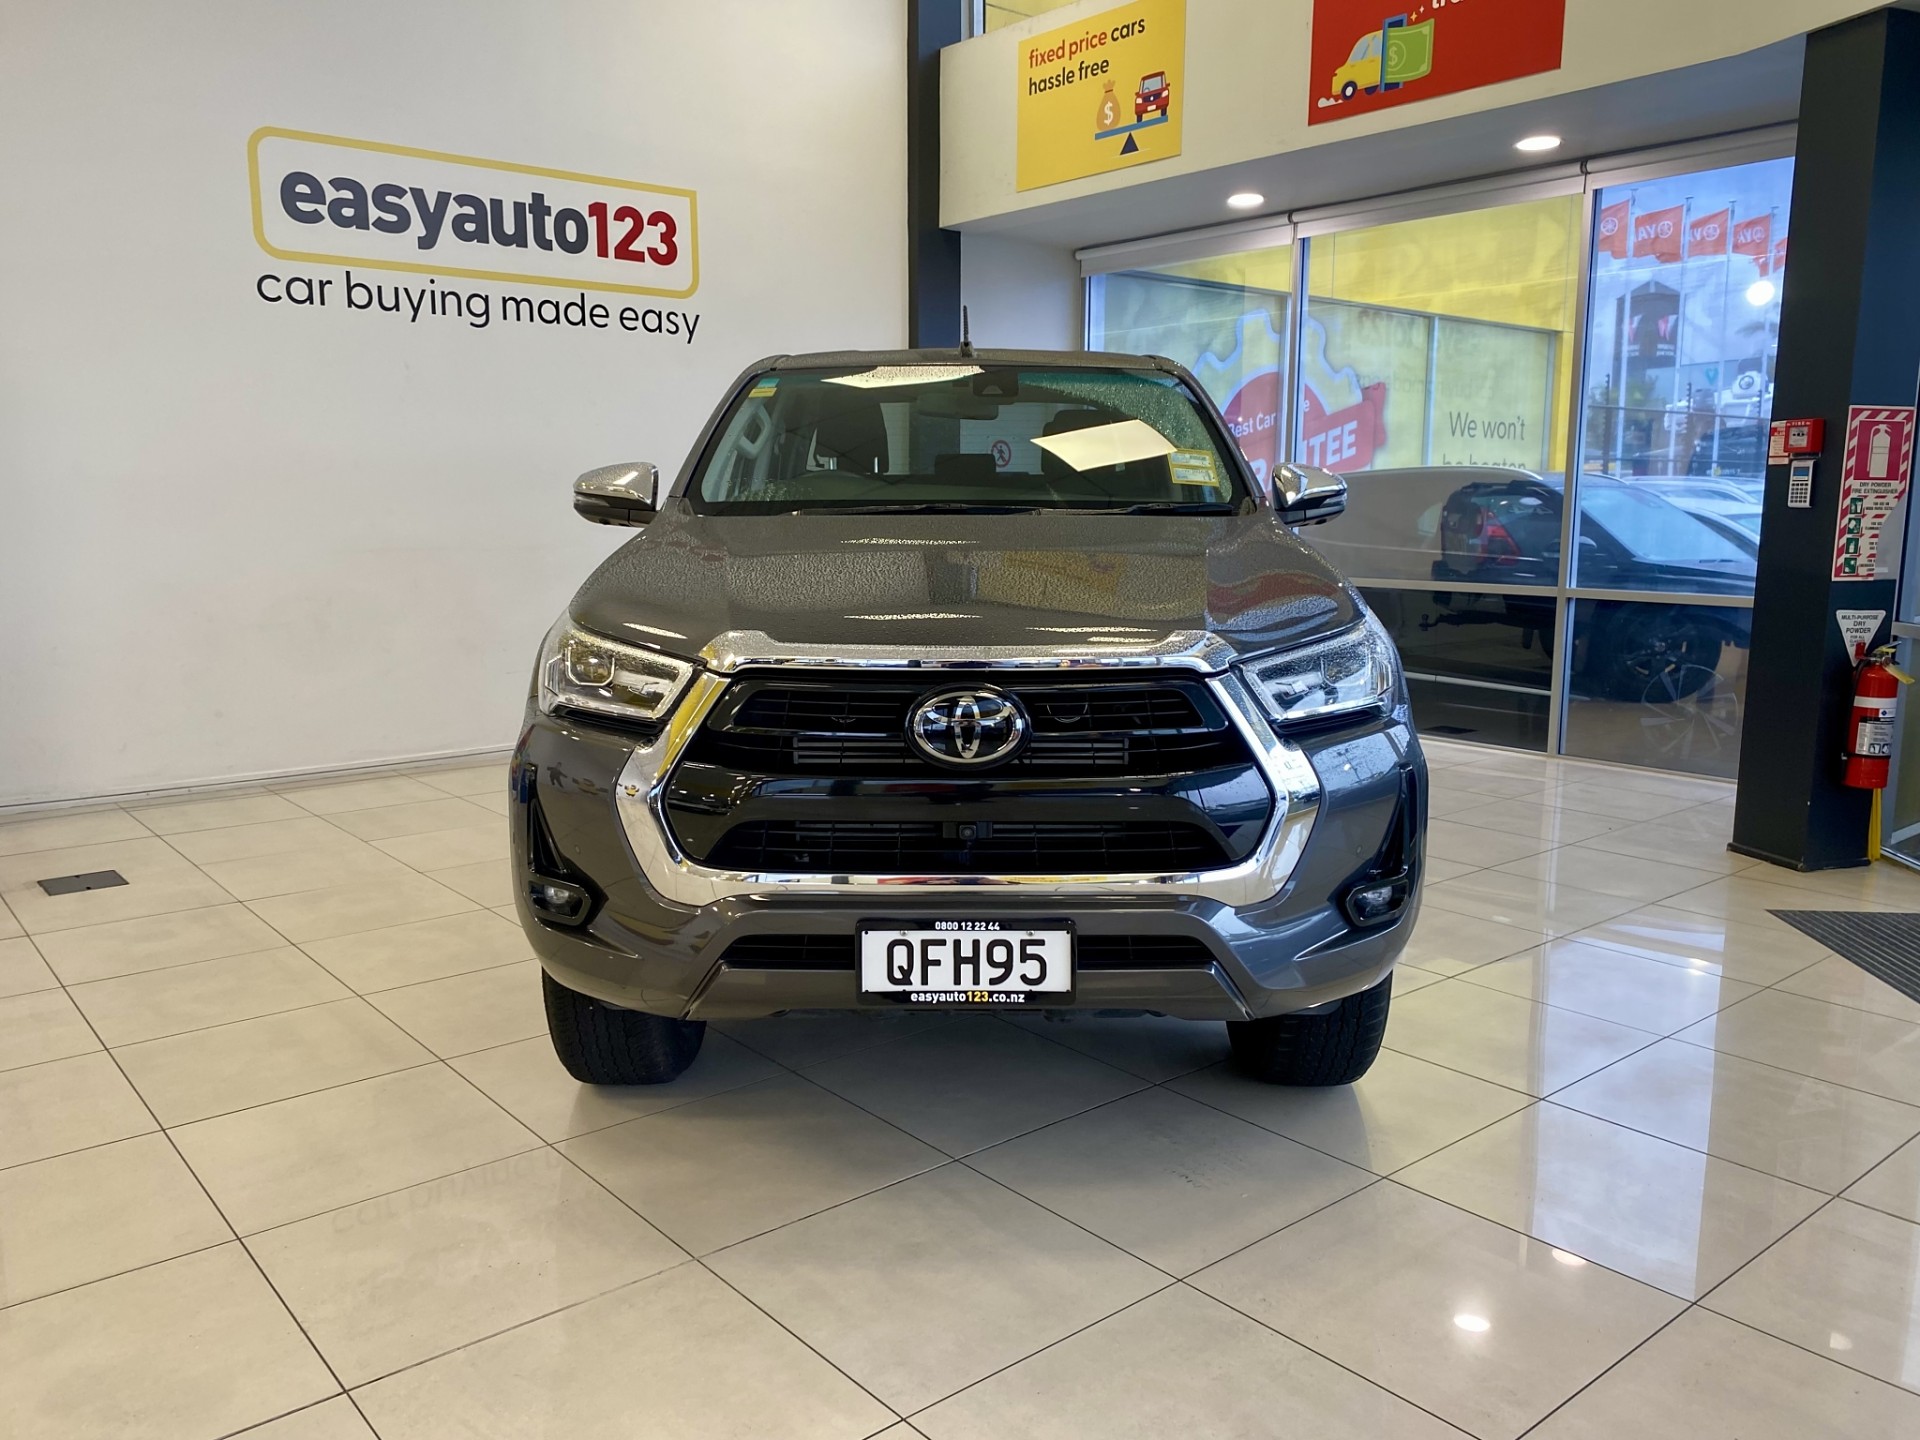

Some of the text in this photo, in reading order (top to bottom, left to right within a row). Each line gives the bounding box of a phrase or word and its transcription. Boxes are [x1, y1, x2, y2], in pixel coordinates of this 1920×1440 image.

[1029, 18, 1146, 69] fixed price cars
[1028, 59, 1110, 96] hassle free
[279, 171, 679, 267] easyauto123
[256, 271, 701, 345] car buying made easy
[1256, 412, 1277, 431] Car
[1449, 411, 1526, 441] We won't
[935, 921, 1000, 931] 0800 12 22 44
[886, 938, 1047, 986] QFH95
[910, 991, 1025, 1004] easyauto123.co.nz
